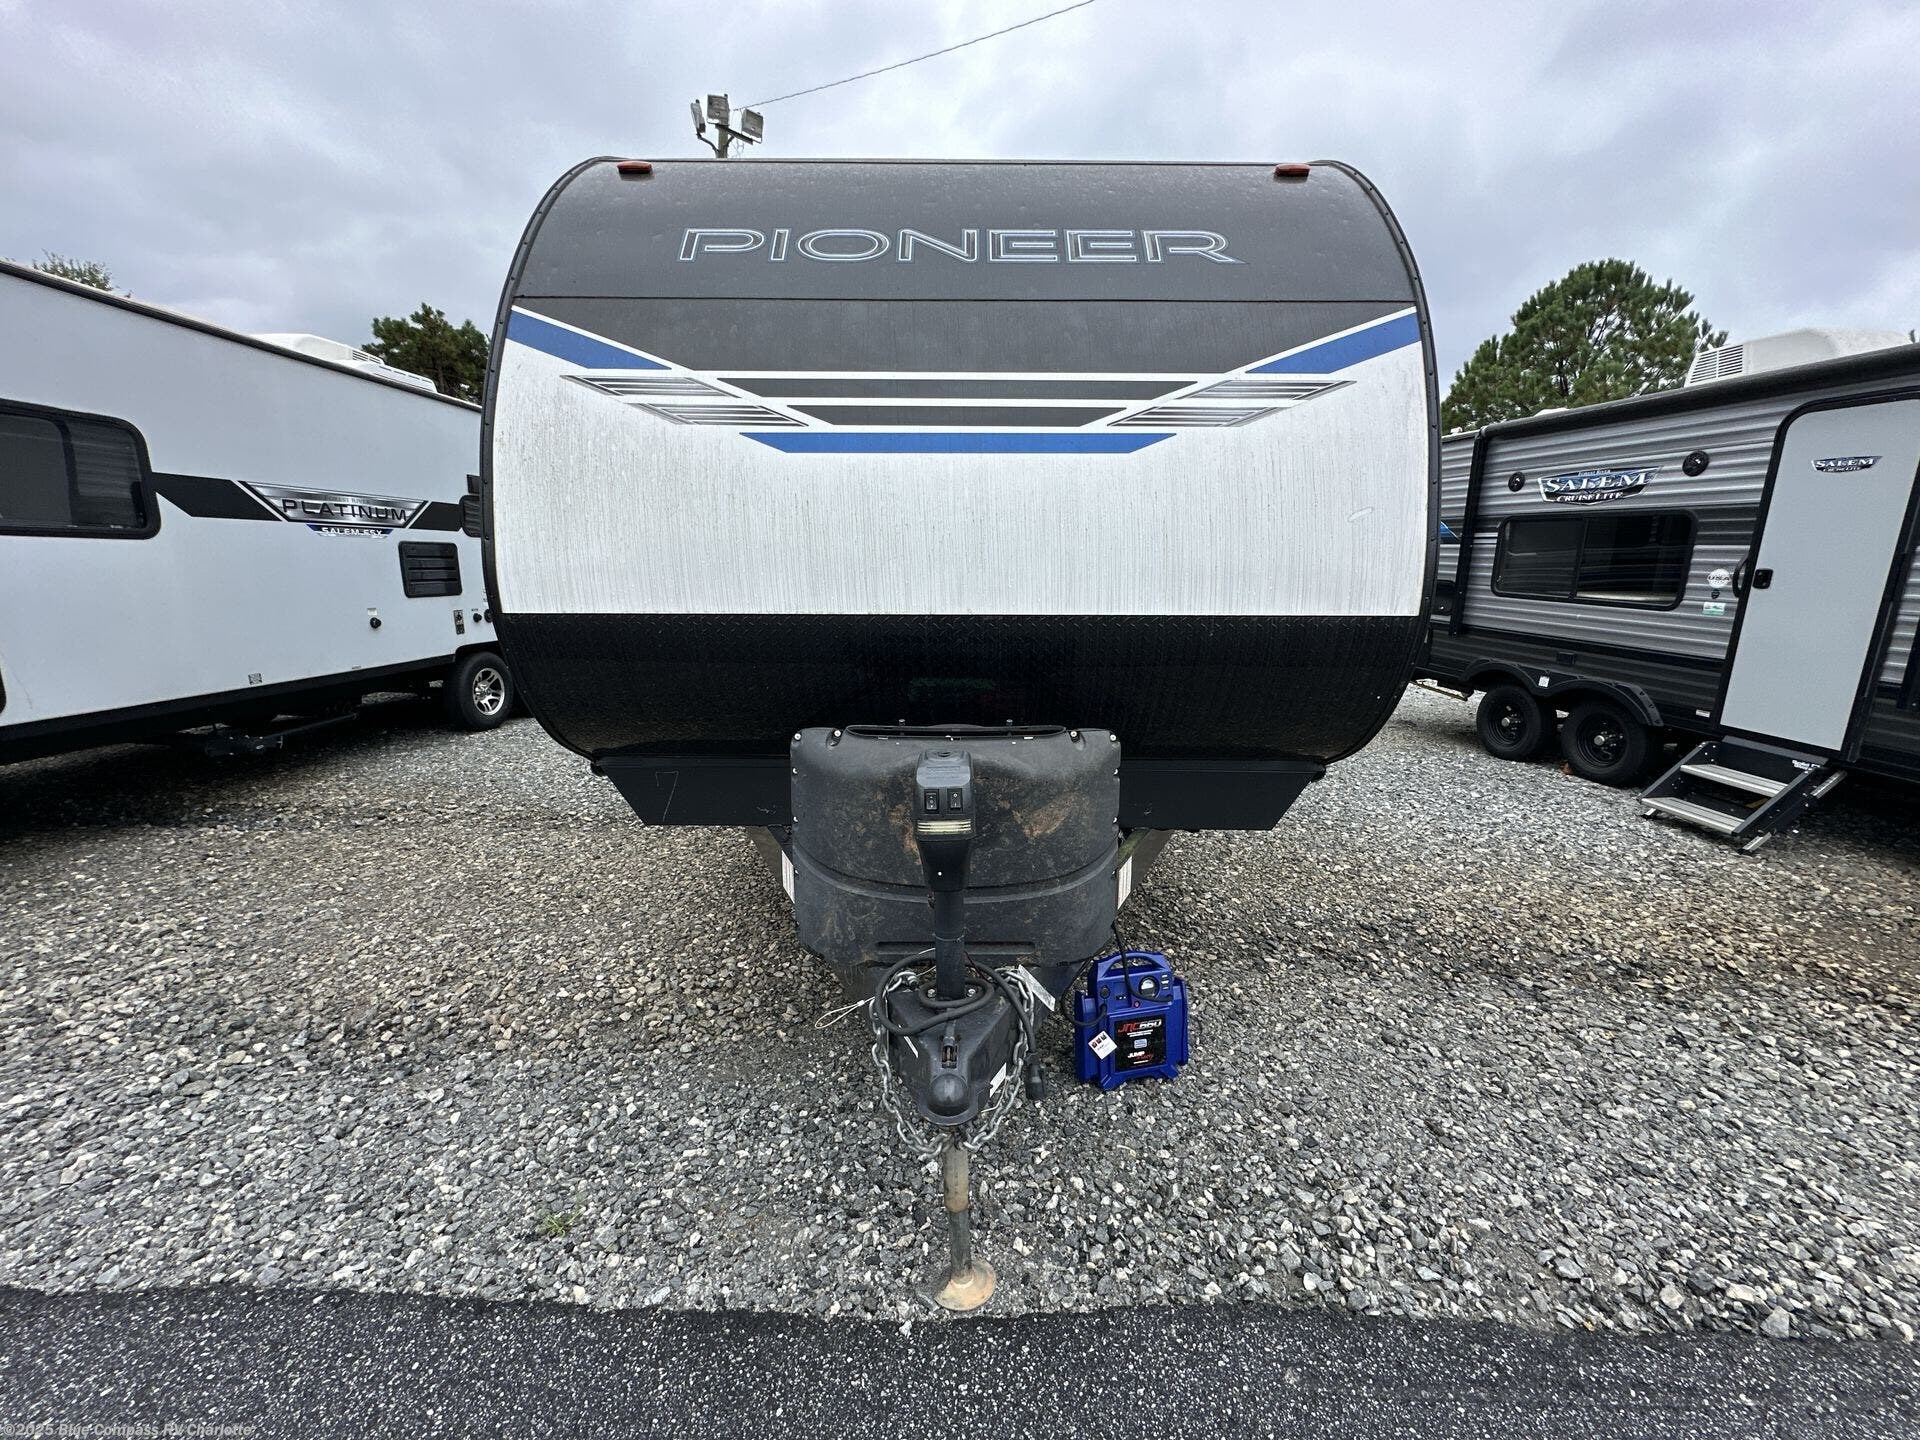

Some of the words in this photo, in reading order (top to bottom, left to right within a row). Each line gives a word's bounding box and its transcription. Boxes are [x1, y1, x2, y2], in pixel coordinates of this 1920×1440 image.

[677, 228, 1246, 263] PIONEER
[1815, 458, 1874, 468] SALEM
[1545, 472, 1647, 492] SALEM
[281, 499, 407, 521] PLATINUM
[321, 527, 361, 536] SALEM
